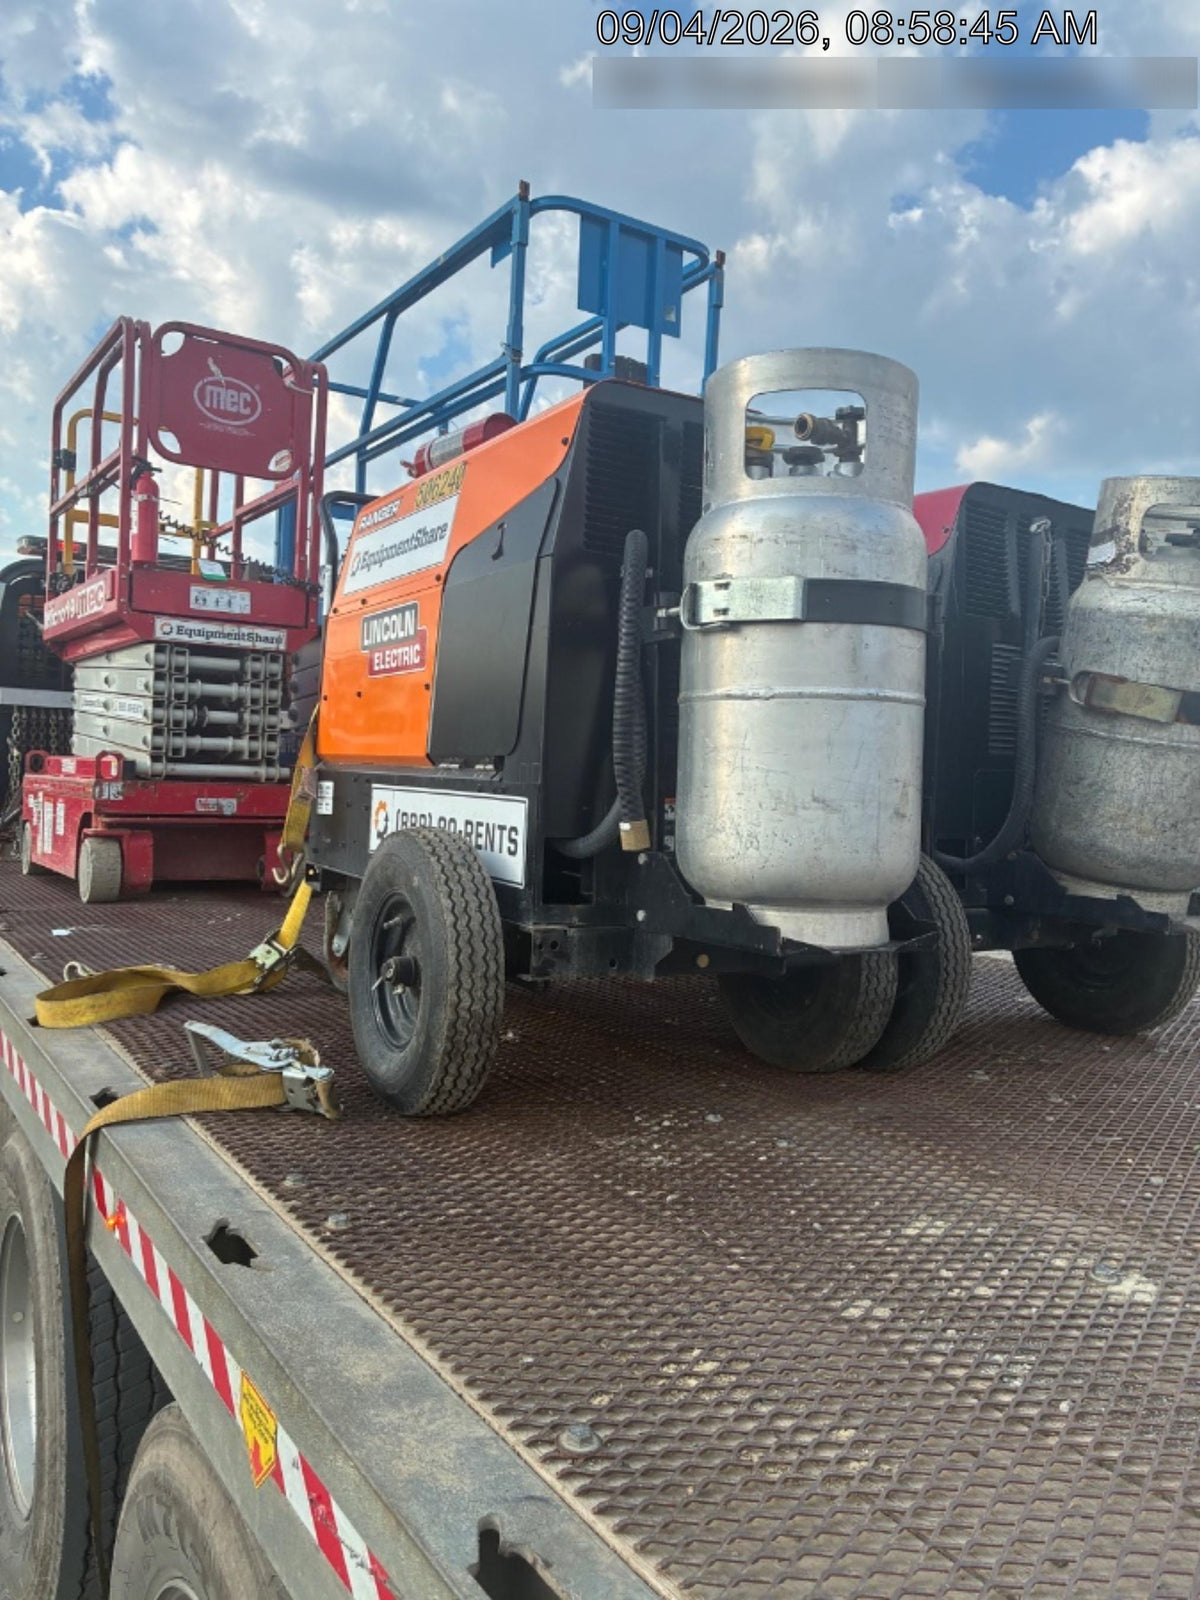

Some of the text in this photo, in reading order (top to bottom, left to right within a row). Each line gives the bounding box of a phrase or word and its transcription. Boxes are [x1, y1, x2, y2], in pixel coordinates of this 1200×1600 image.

[360, 522, 449, 572] EquipmentShare
[176, 625, 283, 645] EquipmentShare
[363, 609, 415, 646] LINCOLN
[373, 643, 420, 671] ELECTRIC
